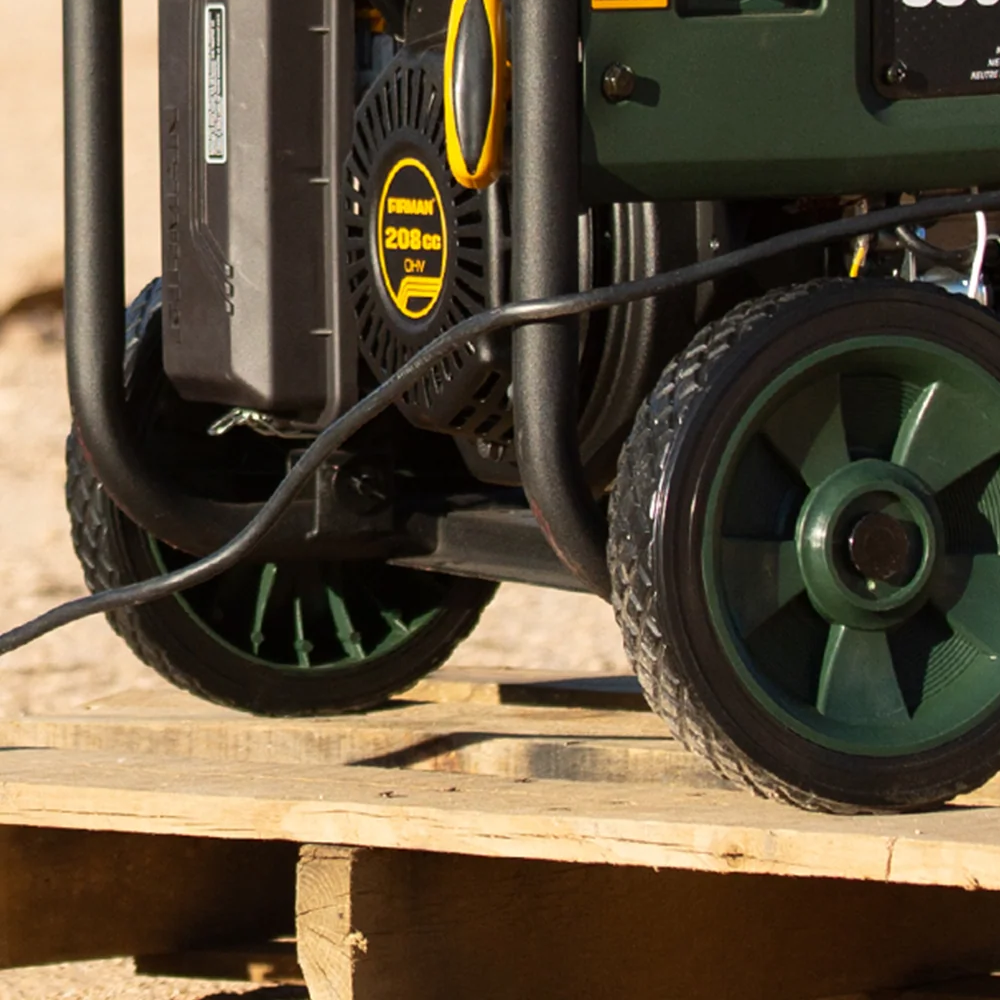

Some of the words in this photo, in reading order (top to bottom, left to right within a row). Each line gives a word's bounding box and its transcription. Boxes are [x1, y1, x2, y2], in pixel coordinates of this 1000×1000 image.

[387, 197, 434, 215] FIRMAN
[384, 226, 441, 250] 208cc
[403, 258, 426, 273] OHV
